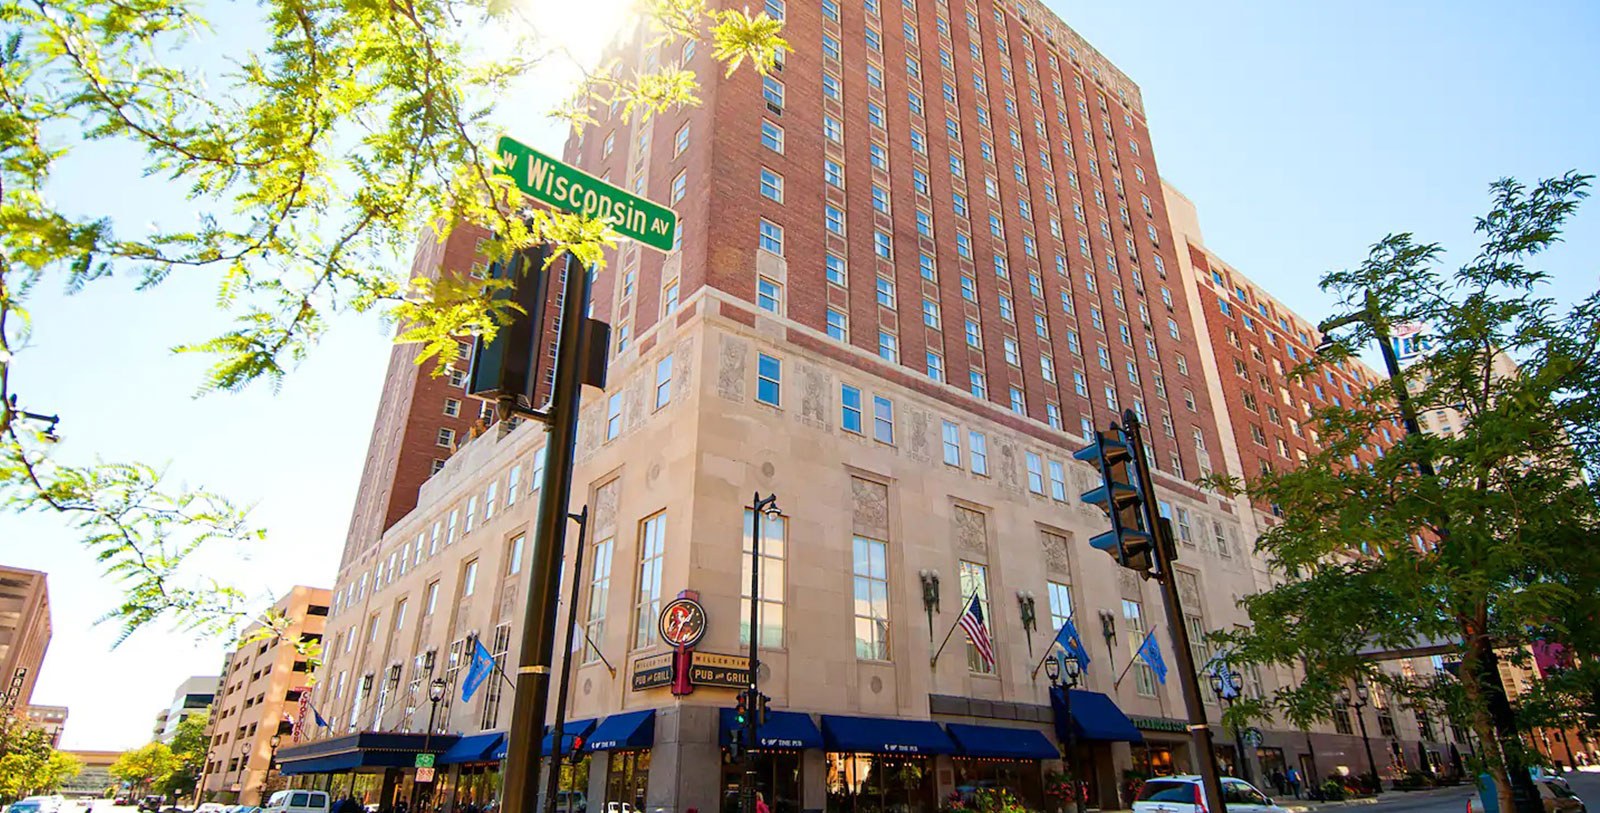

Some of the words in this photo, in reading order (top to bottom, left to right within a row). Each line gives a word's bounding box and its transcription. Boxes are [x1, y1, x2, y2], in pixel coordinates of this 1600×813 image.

[502, 150, 517, 170] W
[527, 154, 647, 235] Wisconsin
[650, 218, 670, 236] AV
[695, 655, 728, 665] MILLER
[731, 658, 750, 667] TIM
[635, 674, 646, 686] PUB
[653, 669, 670, 682] GRILL
[694, 669, 713, 680] PUB
[726, 672, 750, 684] GRILL
